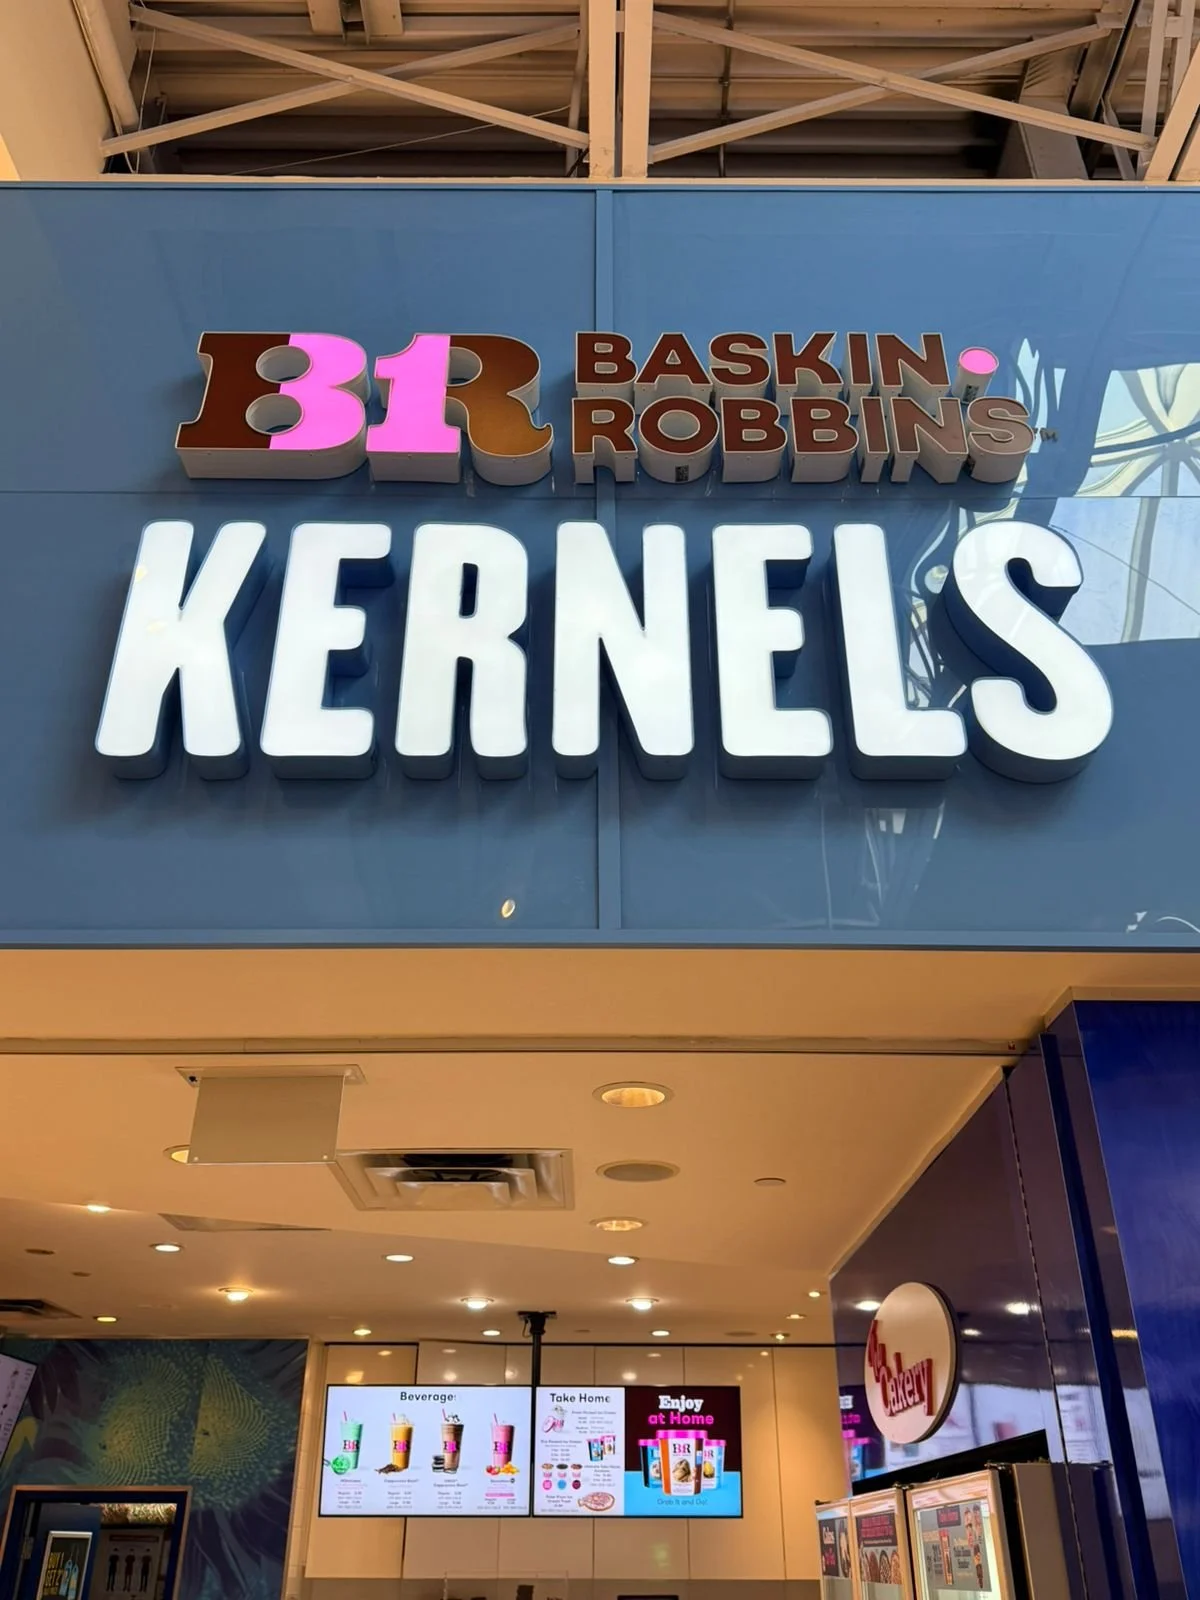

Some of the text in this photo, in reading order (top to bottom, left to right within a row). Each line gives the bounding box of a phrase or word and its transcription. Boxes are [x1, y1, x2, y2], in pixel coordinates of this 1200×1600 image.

[574, 331, 951, 387] BASKIN
[571, 395, 1036, 456] ROBBINS
[95, 520, 1114, 762] KERNELS
[550, 1392, 611, 1404] Take Home
[658, 1394, 704, 1413] Enjoy
[648, 1411, 715, 1425] at Home
